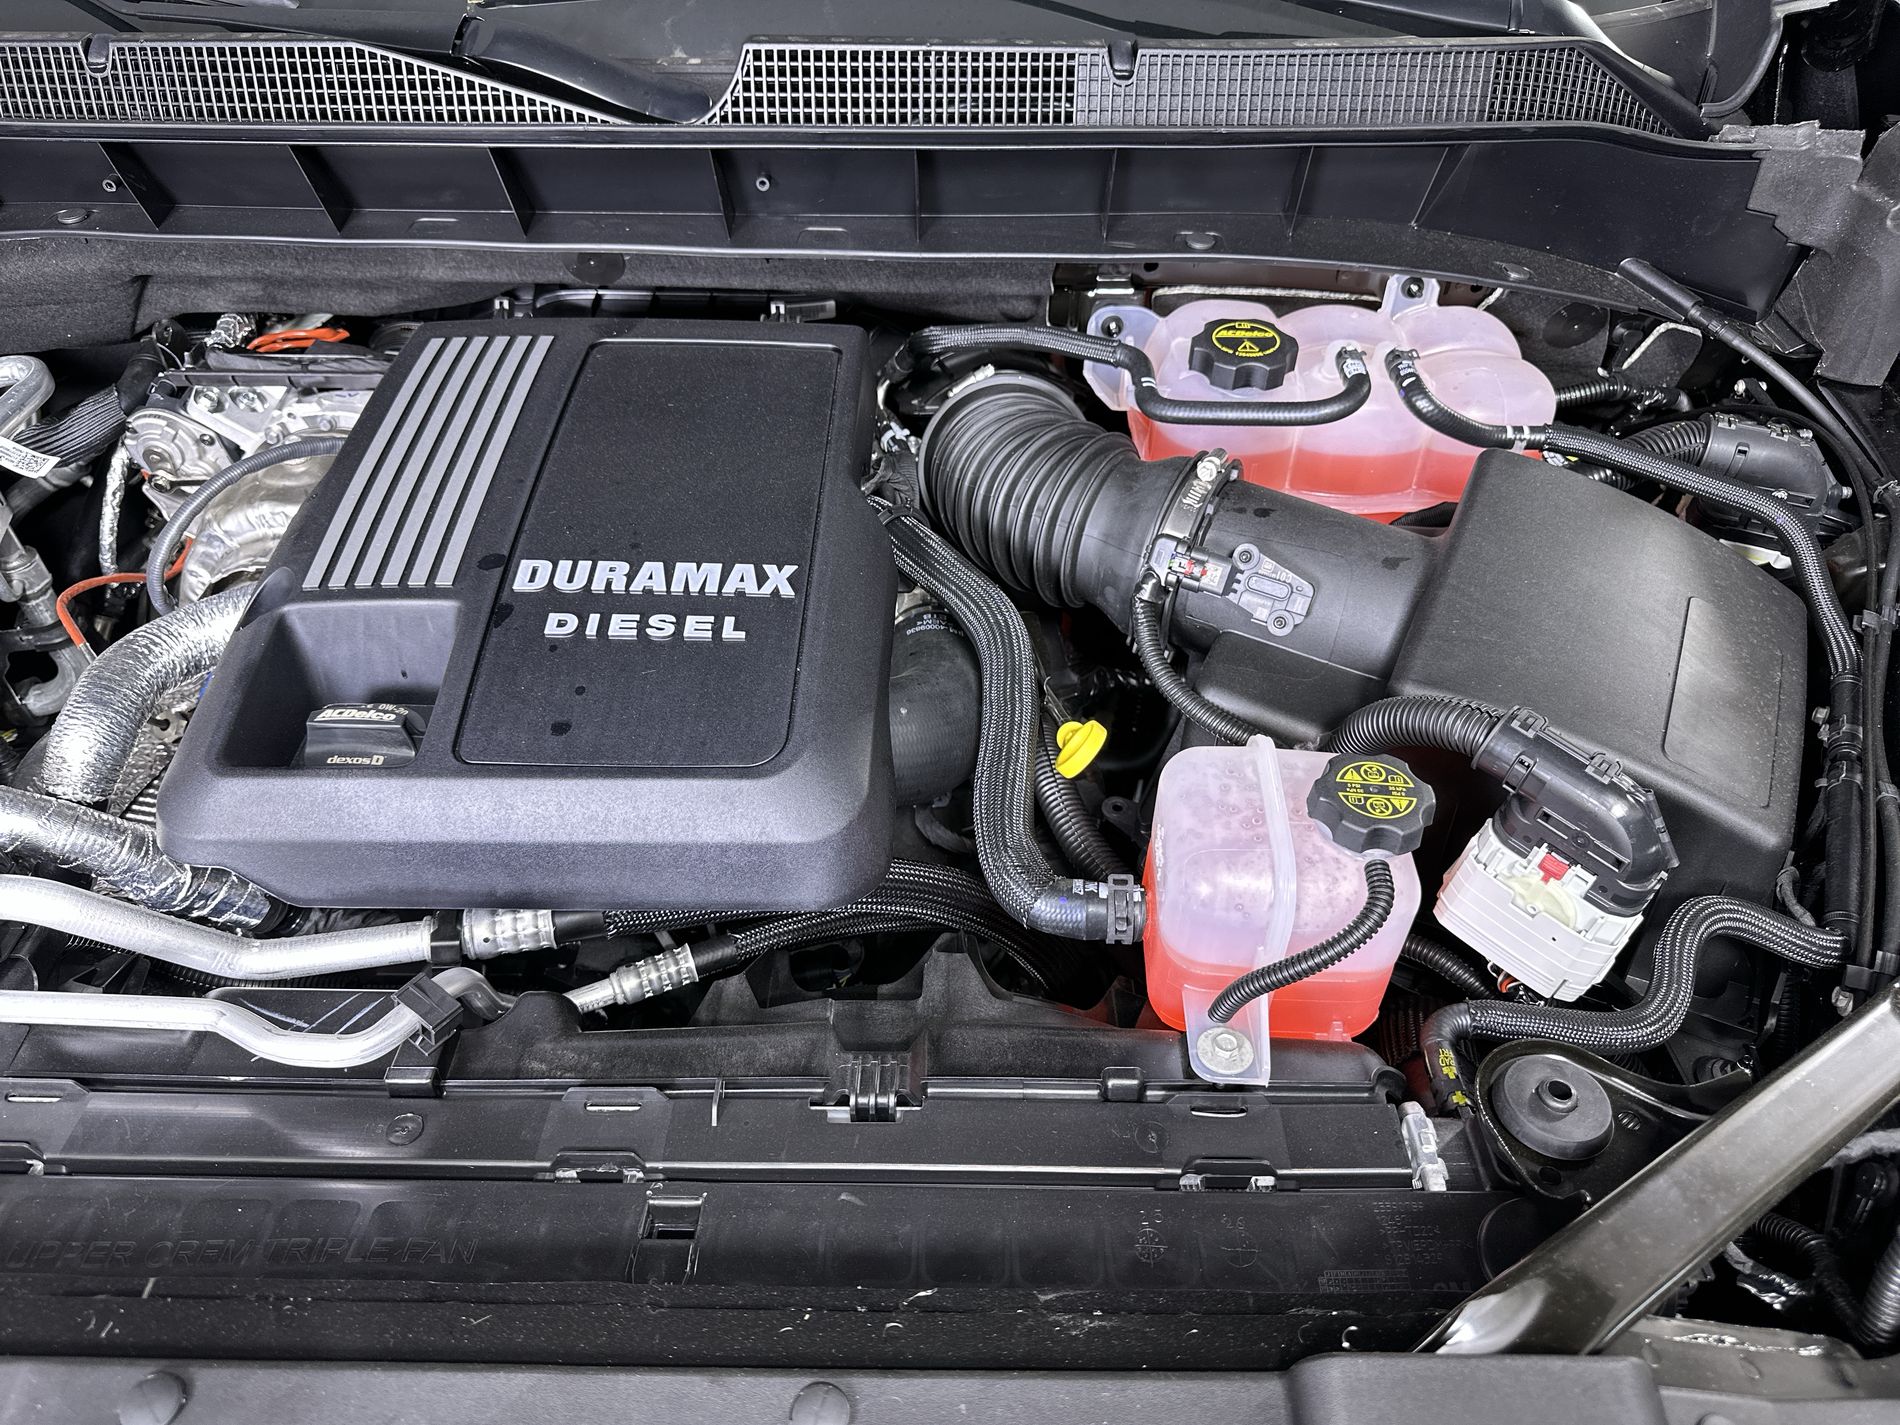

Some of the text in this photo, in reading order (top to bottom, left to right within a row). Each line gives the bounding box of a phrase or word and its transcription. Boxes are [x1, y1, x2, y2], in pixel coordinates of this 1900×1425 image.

[512, 558, 799, 598] DURAMAX
[544, 612, 746, 641] DIESEL
[314, 709, 397, 721] ACDelco
[1439, 1057, 1456, 1066] RAD
[6, 1239, 138, 1269] UPPER
[265, 1237, 393, 1265] TRIPLE
[400, 1237, 480, 1265] FAN
